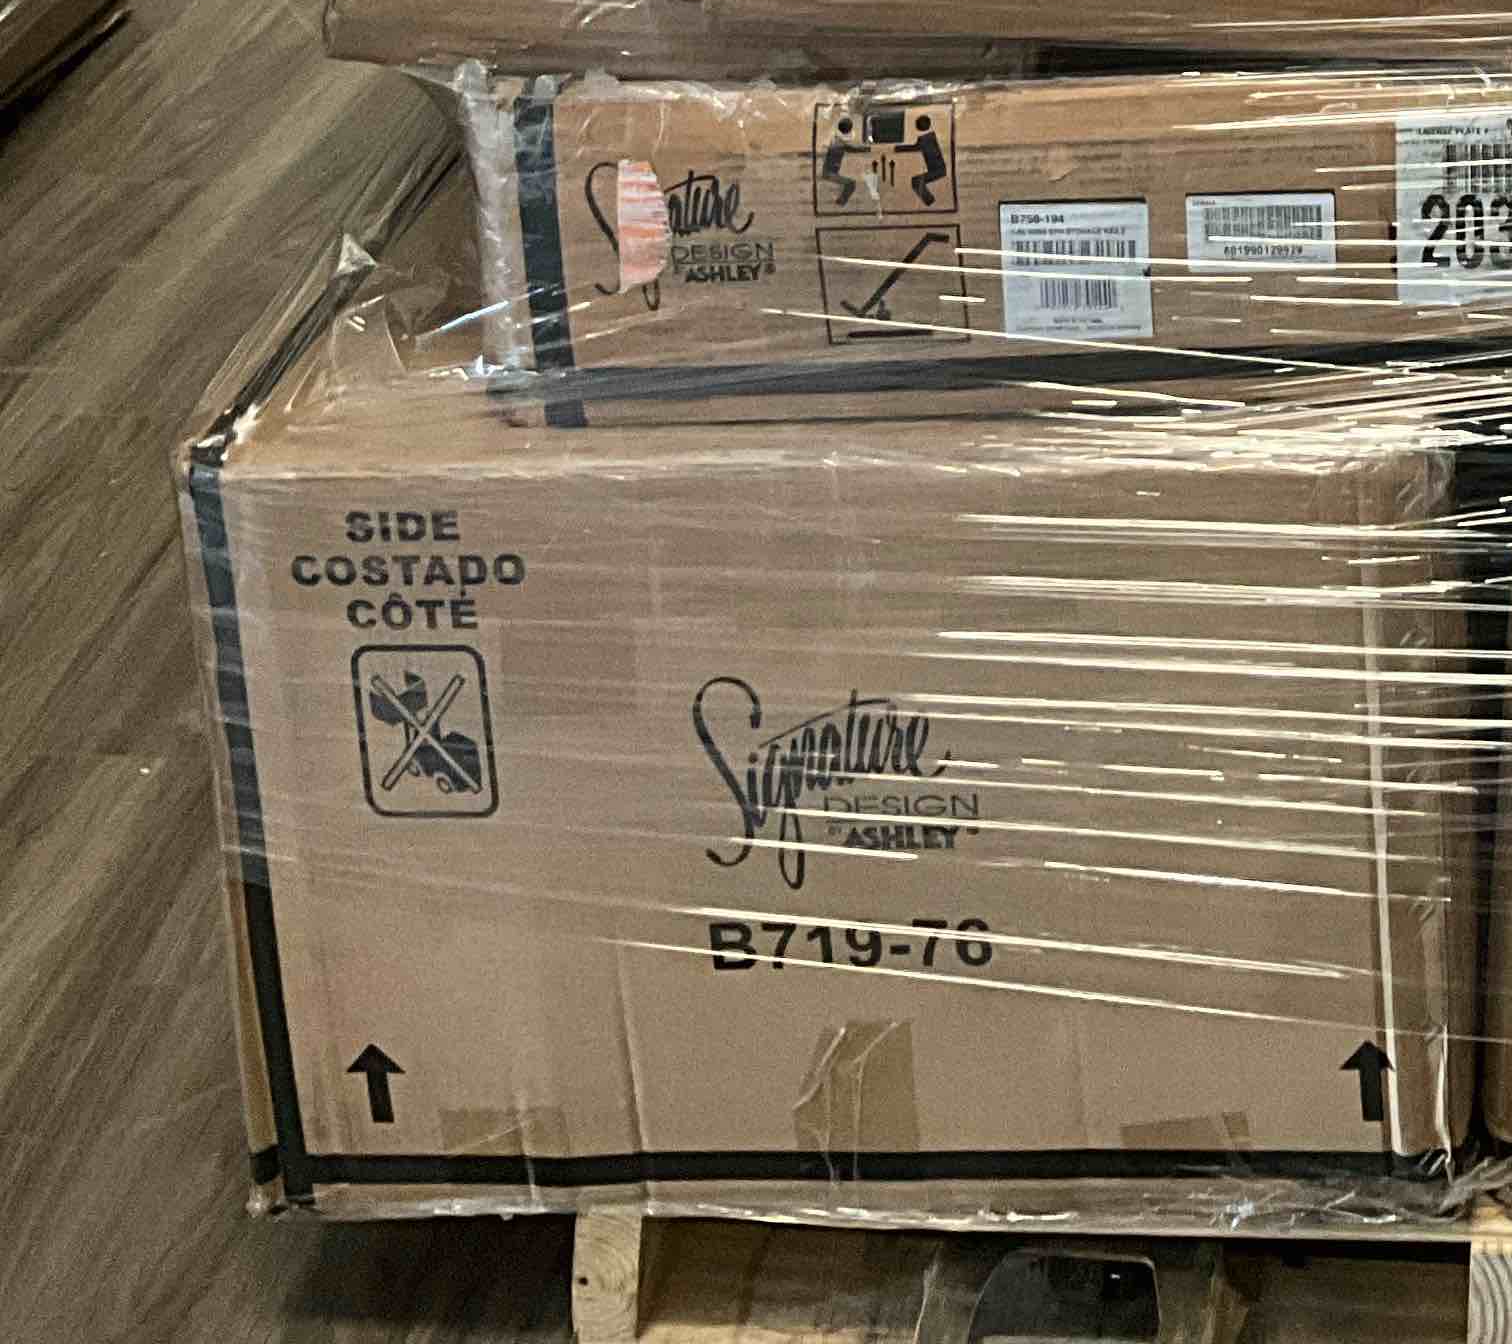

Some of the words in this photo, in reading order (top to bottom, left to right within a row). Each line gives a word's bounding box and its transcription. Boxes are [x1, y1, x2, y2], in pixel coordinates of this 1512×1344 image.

[670, 243, 776, 266] DESIGN
[684, 264, 762, 283] ASHLEY
[344, 510, 461, 544] SIDE
[290, 554, 527, 588] COSTADO
[346, 588, 479, 631] CÔTÉ
[691, 675, 952, 890] Signature
[823, 793, 980, 819] DESIGN
[842, 825, 958, 850] ASHLEY
[708, 918, 994, 972] B719-76
